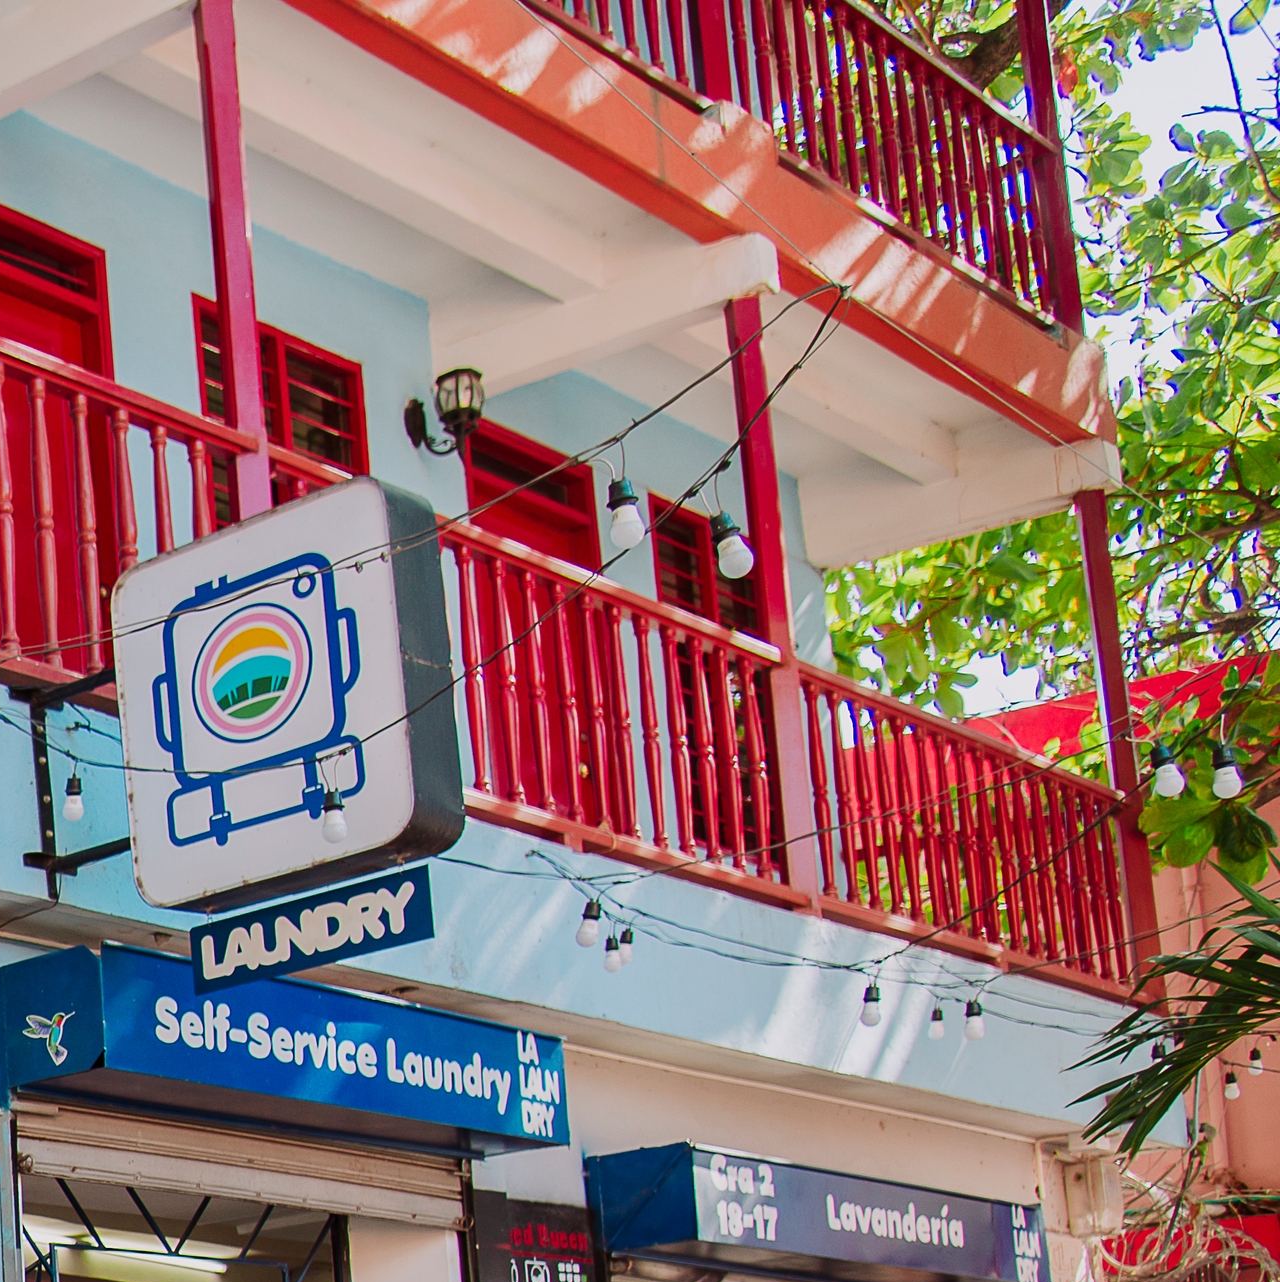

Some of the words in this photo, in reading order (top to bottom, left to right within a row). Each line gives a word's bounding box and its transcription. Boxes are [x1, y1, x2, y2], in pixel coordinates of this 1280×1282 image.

[201, 881, 415, 980] LAUNDRY
[155, 996, 378, 1079] Self-Service
[386, 1037, 511, 1115] Laundry
[517, 1030, 539, 1066] LA
[521, 1099, 555, 1138] DRY
[710, 1154, 754, 1194] Cra
[758, 1164, 775, 1198] 2
[716, 1200, 778, 1241] 18-17
[826, 1193, 964, 1248] Lavandería
[1011, 1204, 1026, 1229] LA
